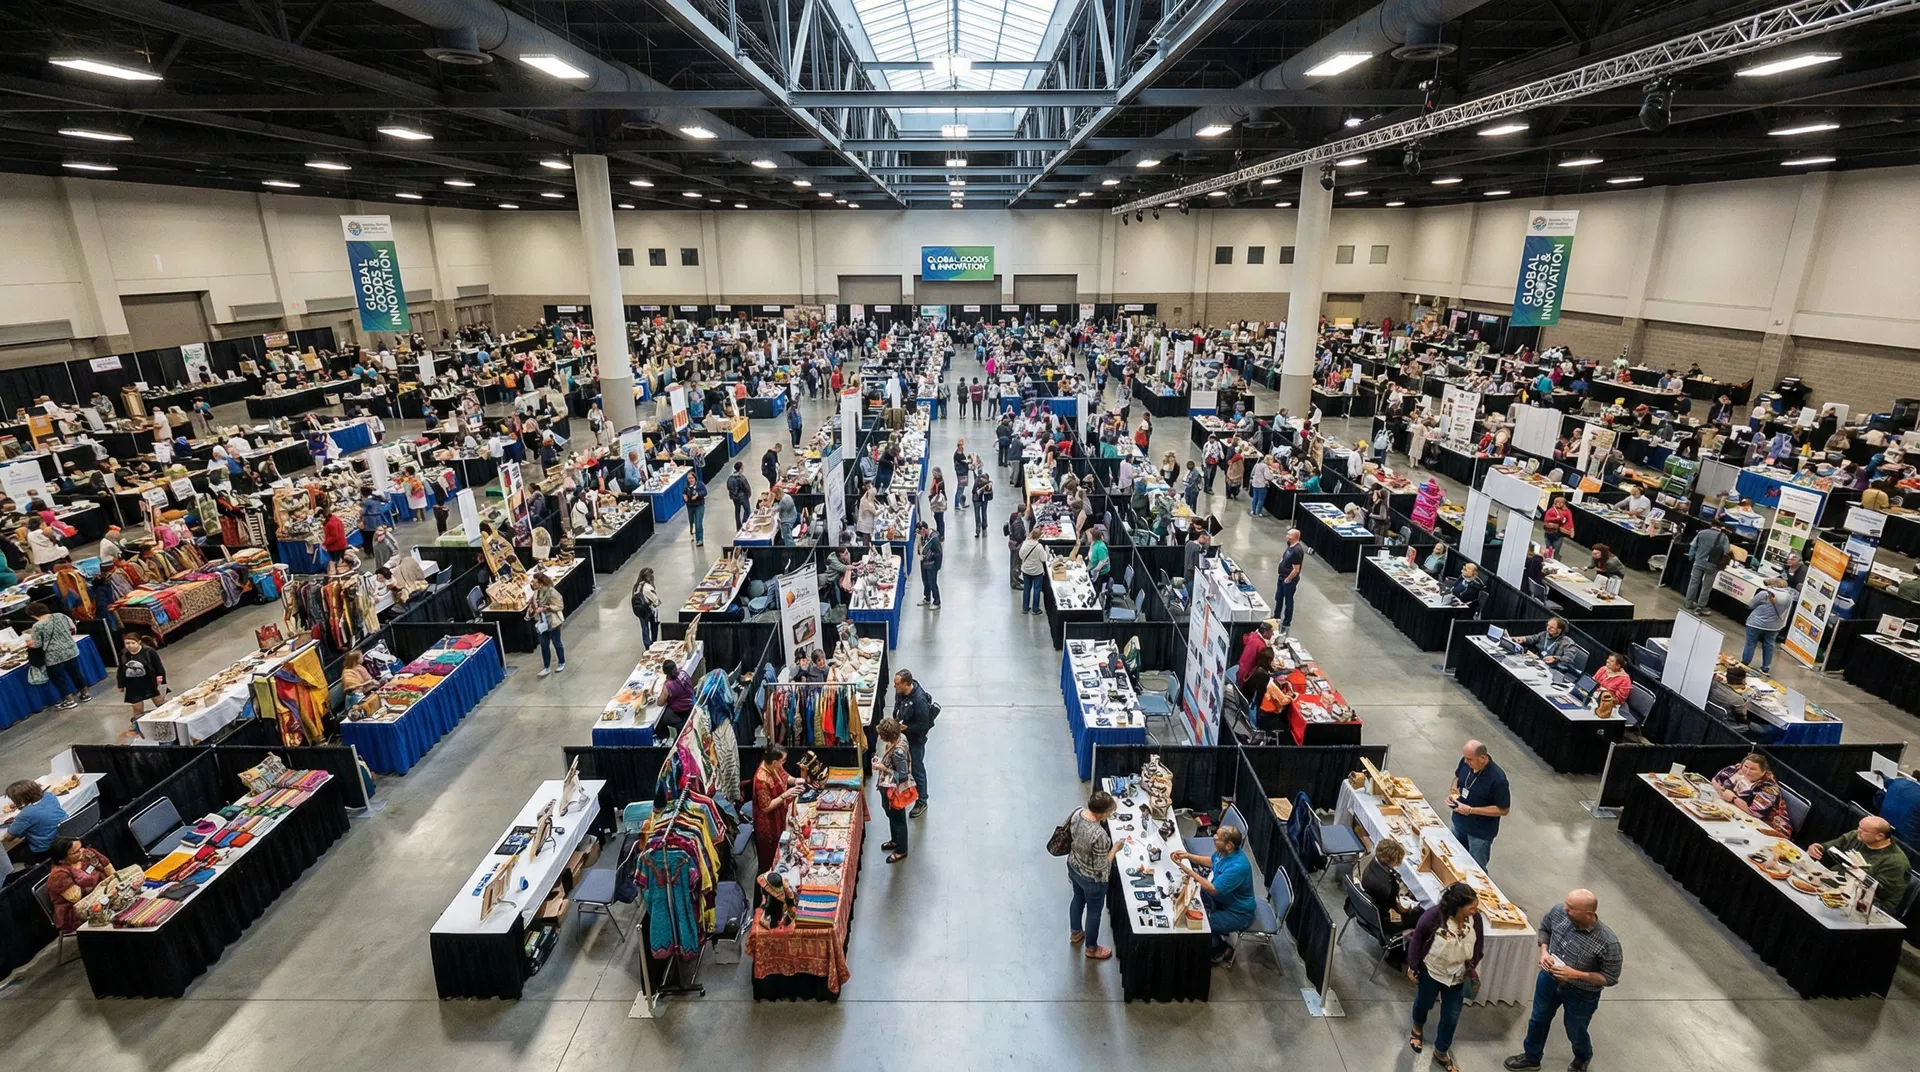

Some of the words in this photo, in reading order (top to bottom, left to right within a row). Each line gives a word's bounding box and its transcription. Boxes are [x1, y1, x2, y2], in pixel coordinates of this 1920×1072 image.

[369, 259, 379, 267] &
[937, 262, 986, 271] INNOVATION
[1522, 254, 1540, 305] GLOBAL
[1540, 253, 1551, 262] &
[358, 259, 377, 310] GLOBAL
[371, 270, 388, 313] GOODS
[378, 249, 402, 325] INNOVATION
[1541, 244, 1565, 320] INNOVATION
